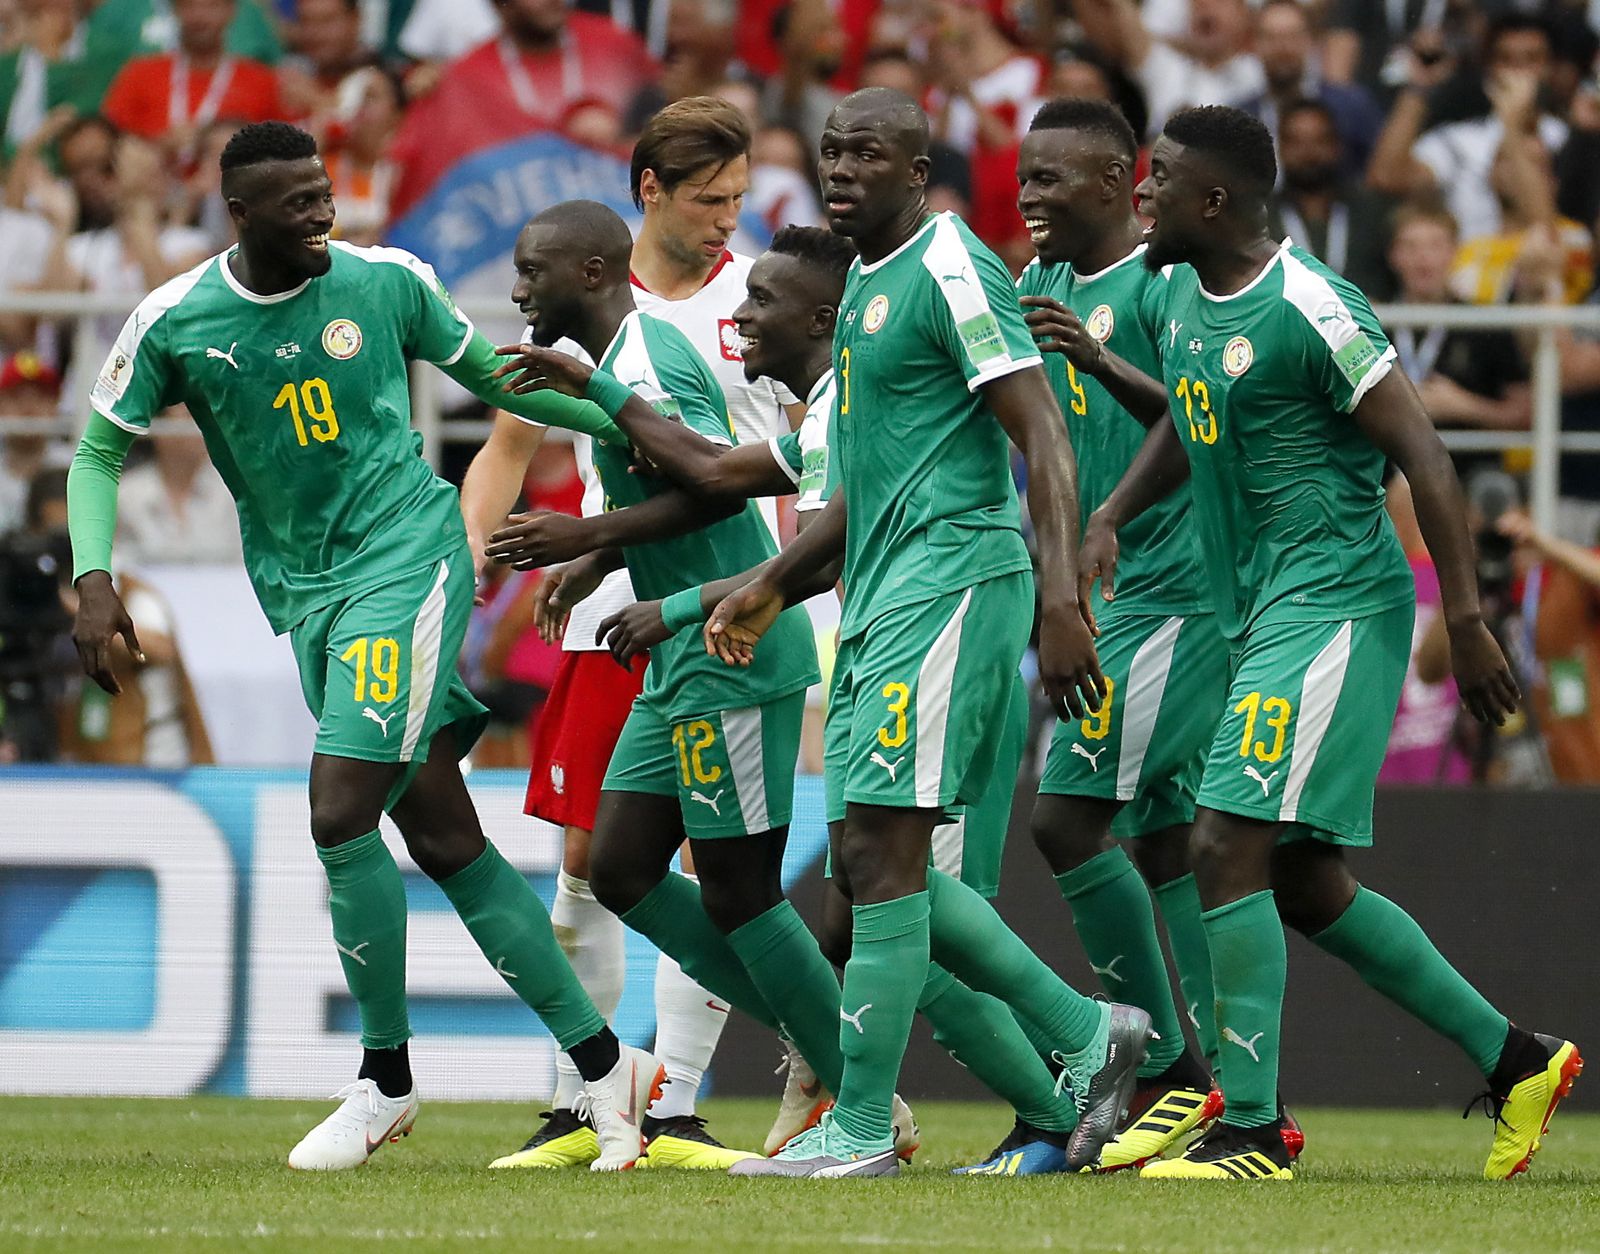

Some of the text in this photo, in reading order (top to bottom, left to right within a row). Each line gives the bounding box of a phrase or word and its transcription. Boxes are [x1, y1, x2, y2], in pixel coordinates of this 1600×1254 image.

[273, 377, 339, 446] 19
[1176, 377, 1218, 445] 13
[341, 637, 399, 703] 19
[878, 682, 909, 747] 3
[1234, 691, 1291, 763] 13
[672, 719, 721, 787] 12
